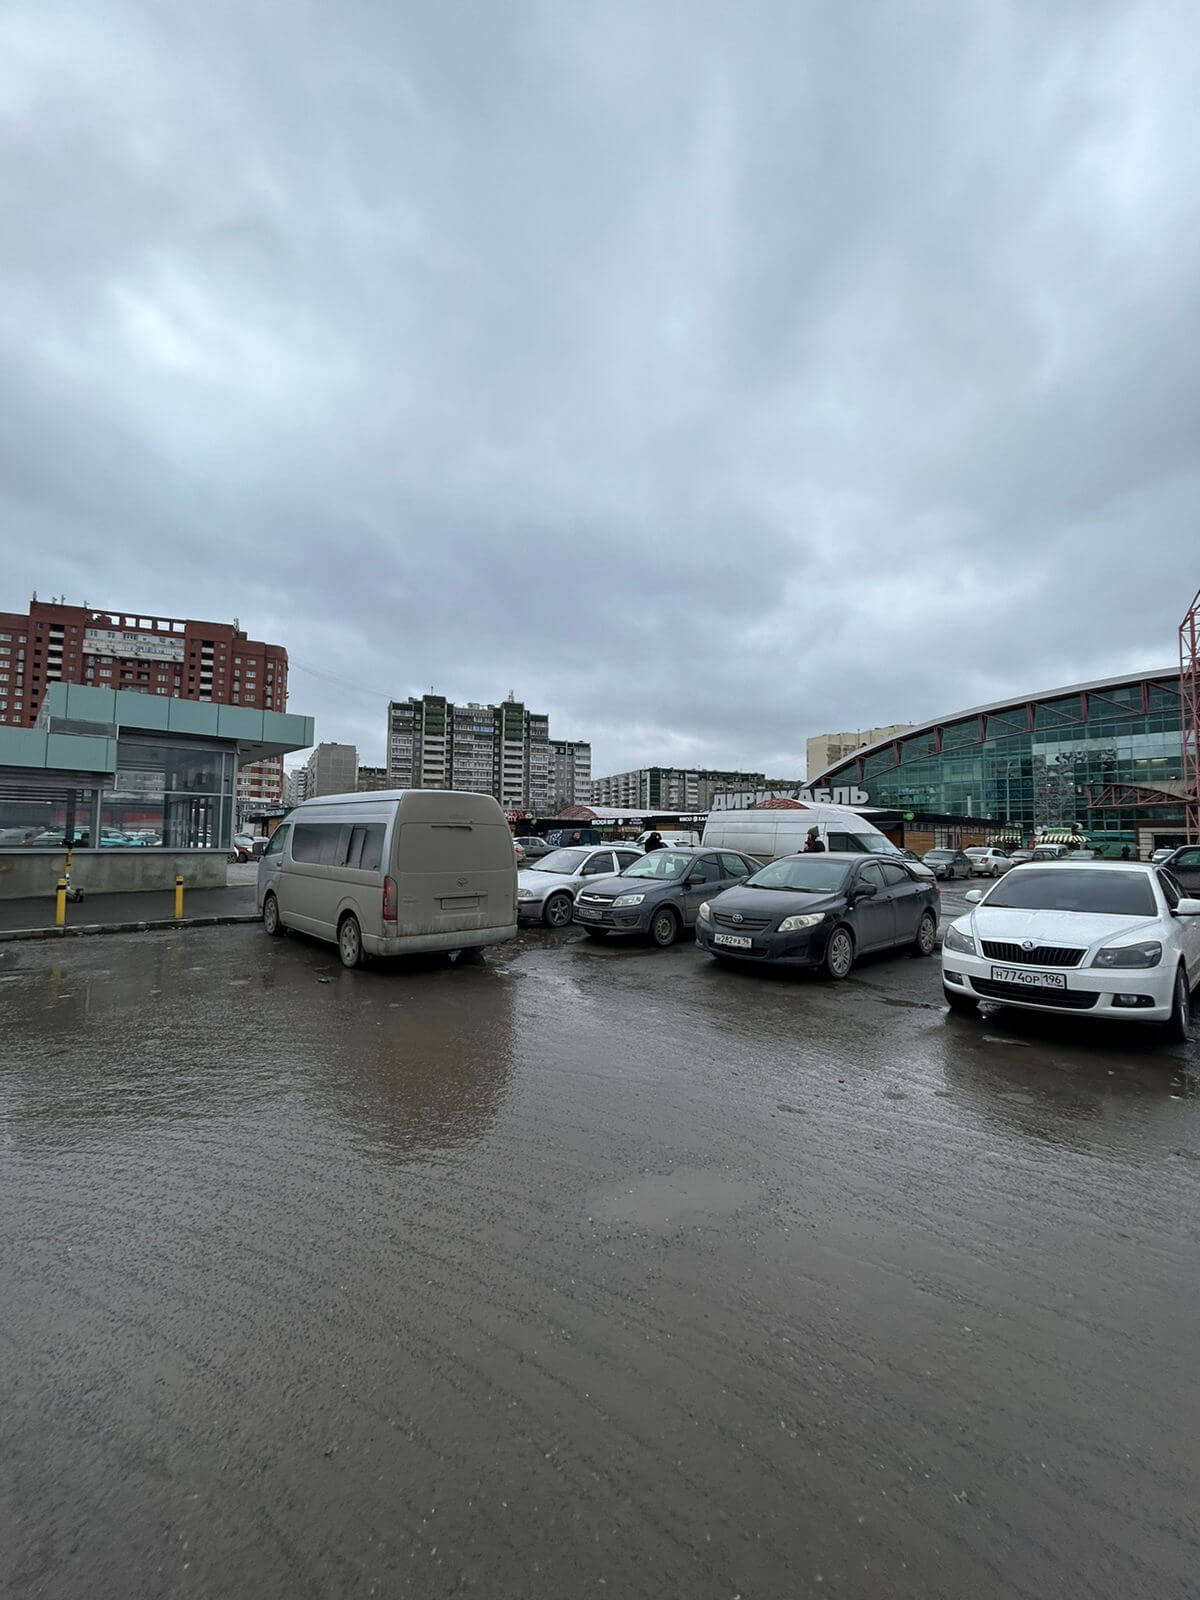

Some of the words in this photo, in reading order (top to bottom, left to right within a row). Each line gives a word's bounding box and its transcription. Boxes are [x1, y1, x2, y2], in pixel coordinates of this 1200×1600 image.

[711, 786, 870, 812] ДИРИЖАБЛЬ
[995, 969, 1040, 984] Н774ОР
[1042, 974, 1063, 984] 196
